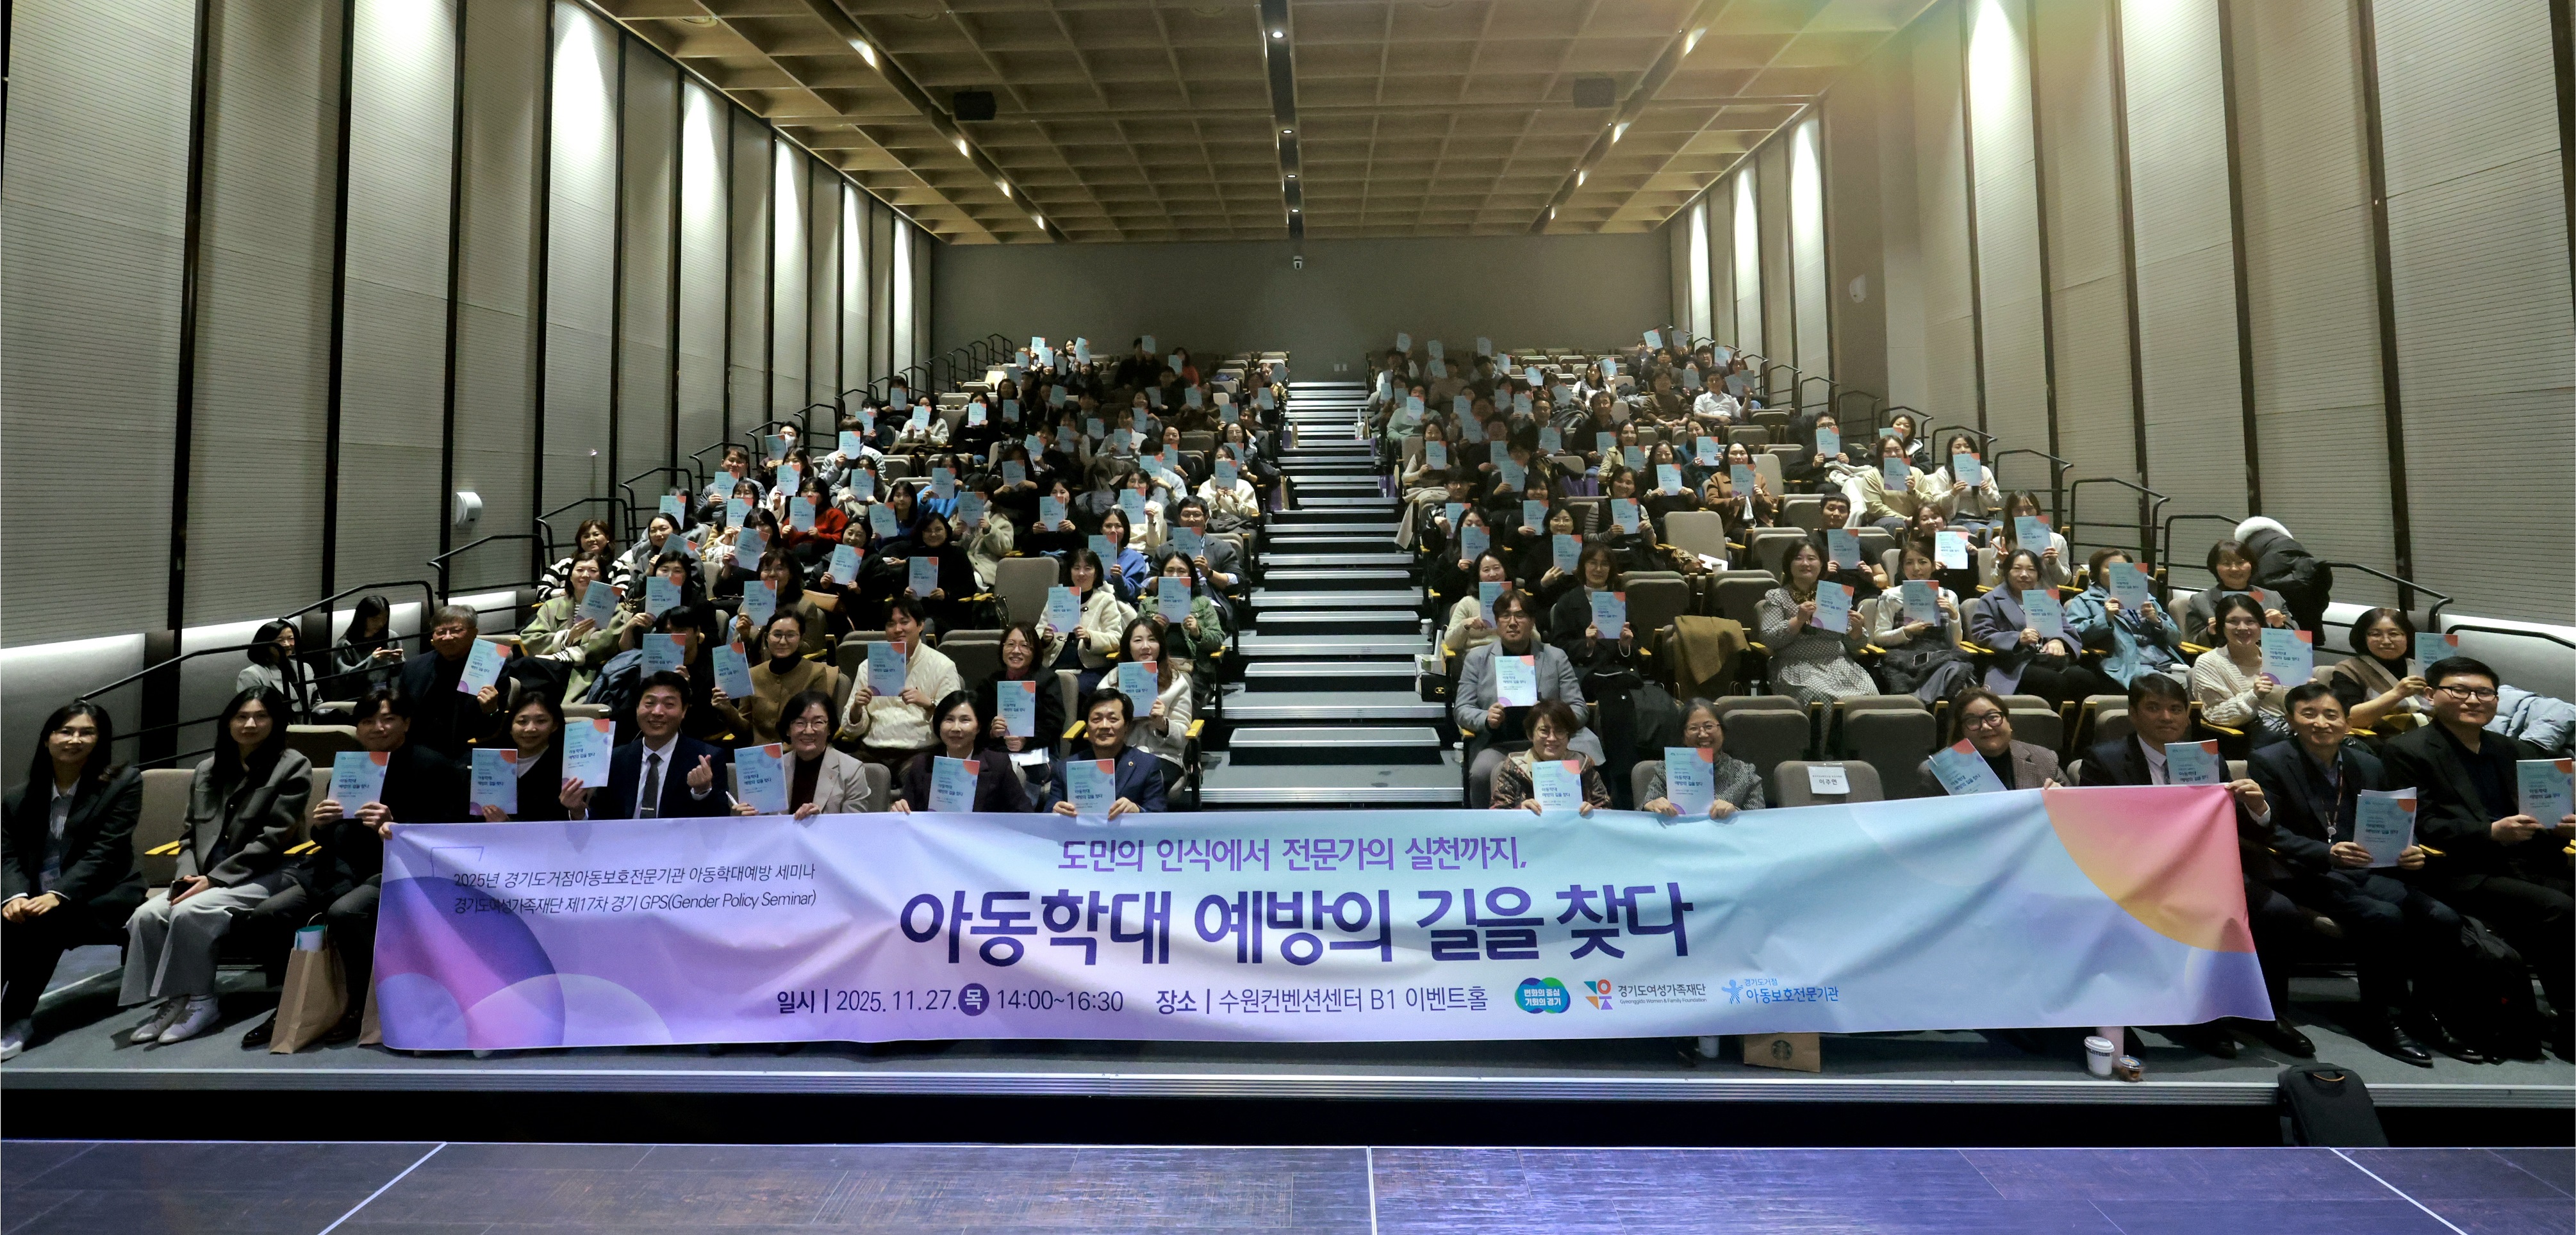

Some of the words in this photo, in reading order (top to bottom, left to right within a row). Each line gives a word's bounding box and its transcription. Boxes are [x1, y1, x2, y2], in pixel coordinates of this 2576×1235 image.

[1059, 839, 1144, 872] 도민의
[1160, 838, 1269, 872] 인식에서
[1282, 838, 1394, 871] 전문가의
[1405, 837, 1528, 870] 실천까지,
[454, 872, 500, 888] 2025년
[504, 867, 685, 888] 경기도거점아동보호전문기관
[689, 865, 772, 883] 아동학대예방
[775, 863, 815, 880] 세미나
[455, 897, 563, 914] 경기도여성가족재단
[565, 896, 609, 914] 제17차
[611, 895, 638, 912] 경기
[640, 894, 720, 911] GPS(Gender
[722, 892, 758, 910] Policy
[761, 889, 816, 906] Seminar)
[900, 889, 1171, 967] 아동학대
[1194, 890, 1393, 966] 예방의
[1416, 887, 1544, 961] 길을
[1556, 882, 1694, 960] 찾다
[777, 990, 814, 1014] 일시
[964, 989, 983, 1010] 목
[997, 990, 1123, 1011] 14:00~16:30
[1155, 990, 1197, 1015] 장소
[1219, 988, 1362, 1013] 수원컨벤션센터
[1371, 990, 1396, 1010] B1
[1405, 986, 1489, 1011] 이벤트홀
[1524, 988, 1545, 997] 변화의
[1525, 997, 1546, 1006] 기회의
[1547, 997, 1561, 1006] 경기
[1618, 984, 1706, 997] 경기도여성가족재단
[1746, 986, 1839, 1004] 아동보호전문기관
